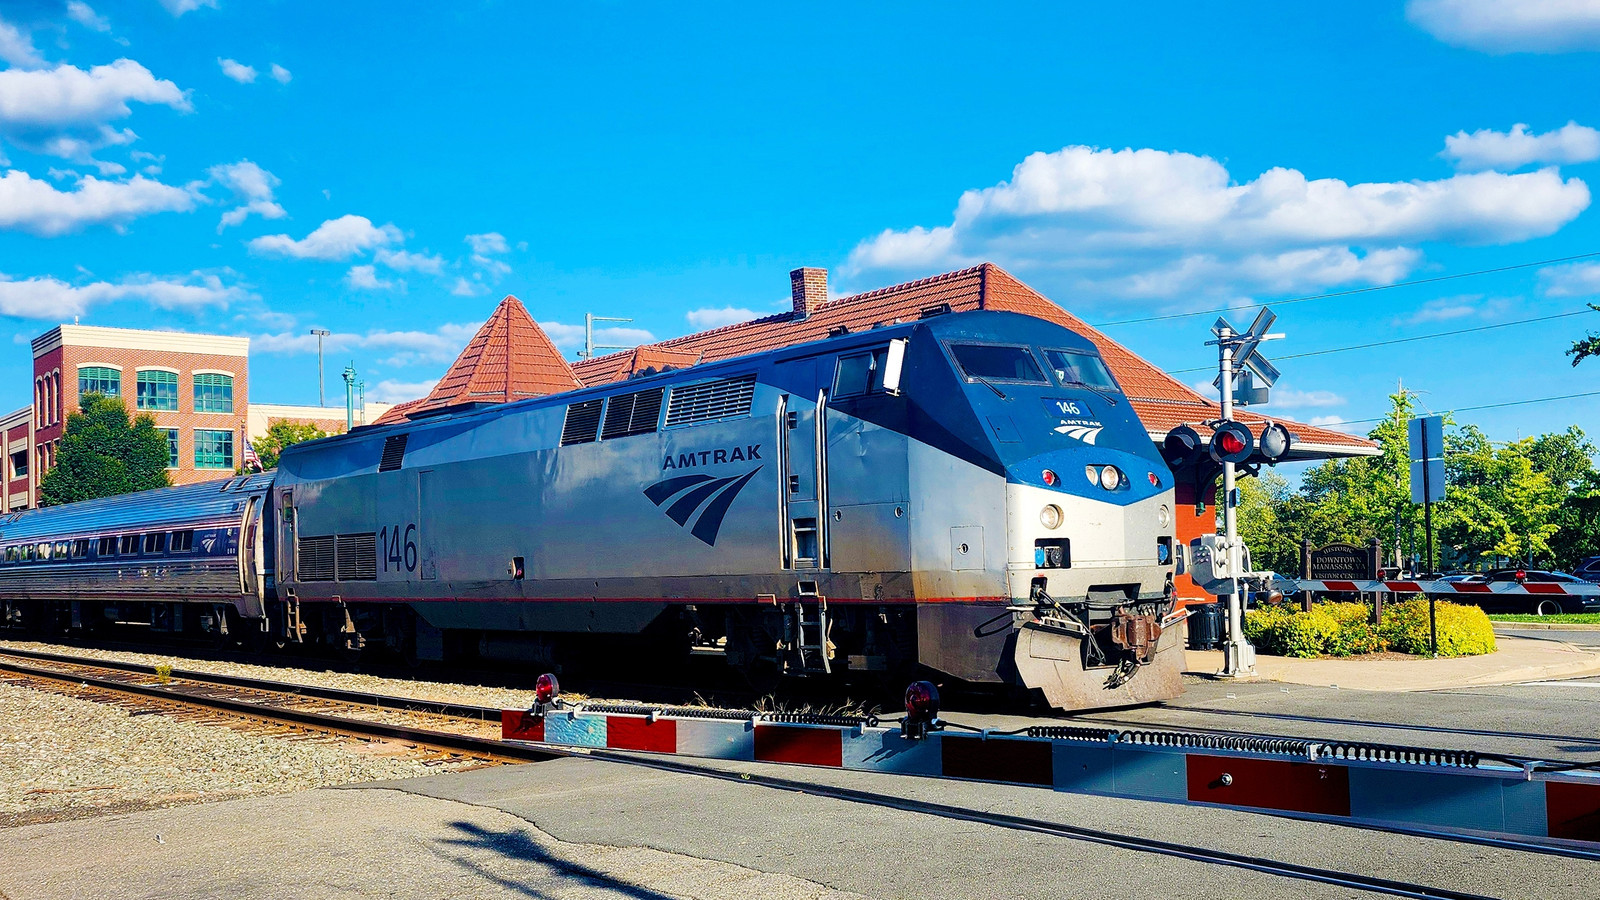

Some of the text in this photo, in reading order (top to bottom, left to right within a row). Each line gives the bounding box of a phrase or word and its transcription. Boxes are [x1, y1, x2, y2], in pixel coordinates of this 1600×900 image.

[1056, 401, 1080, 415] 146
[1060, 419, 1102, 427] AMTRAK
[662, 444, 762, 470] AMTRAK
[380, 523, 417, 573] 146
[1323, 546, 1355, 555] HISTORIC
[1316, 556, 1362, 564] DOWNTOWN
